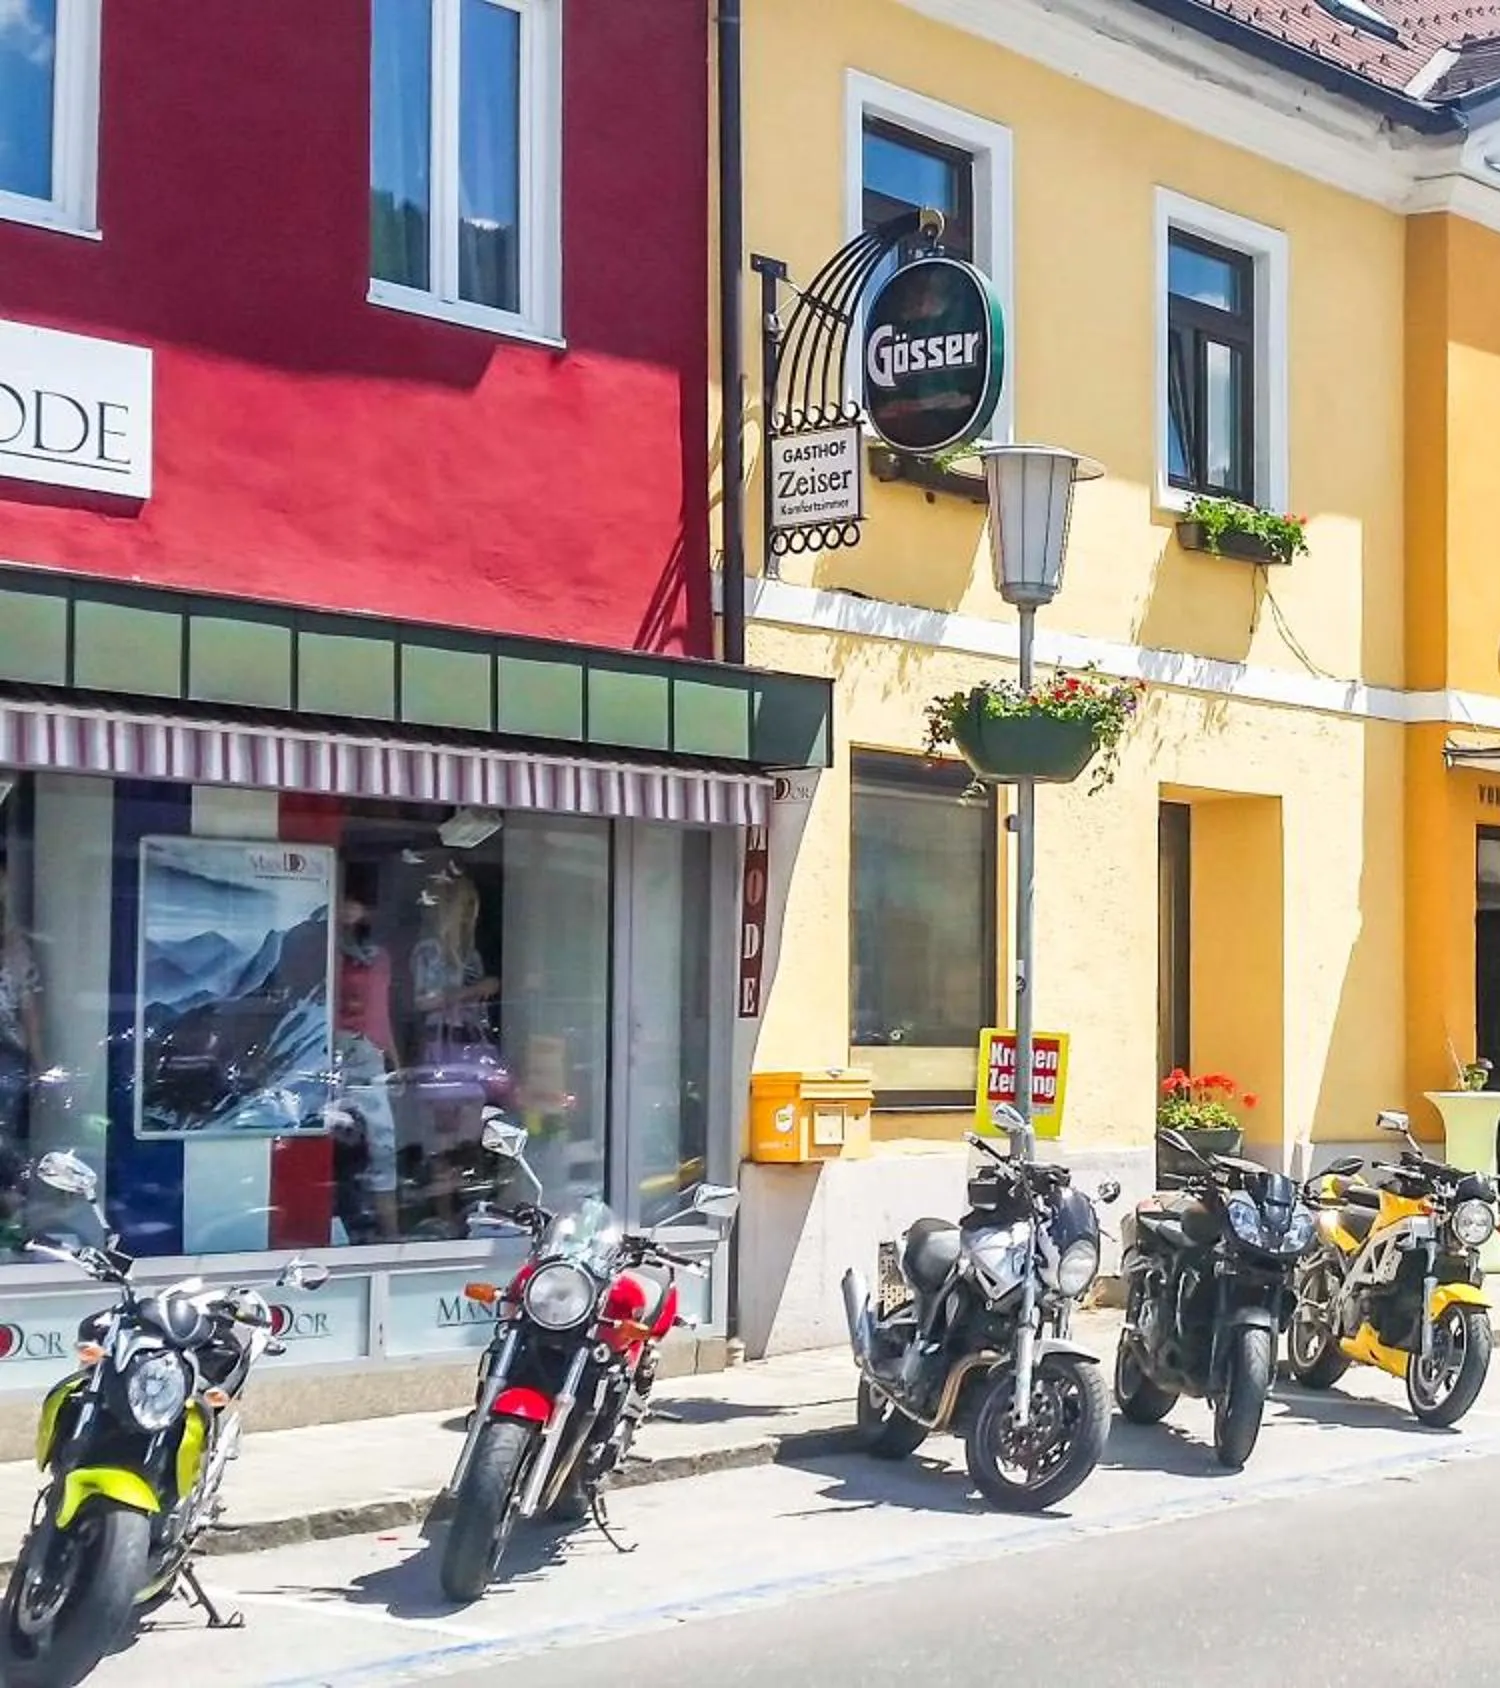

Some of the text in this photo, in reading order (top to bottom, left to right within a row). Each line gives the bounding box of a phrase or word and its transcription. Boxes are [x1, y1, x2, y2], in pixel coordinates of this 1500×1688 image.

[867, 325, 979, 387] Gösser
[783, 441, 847, 463] GASTHOF
[778, 466, 853, 498] Zeiser
[990, 1067, 1056, 1098] Zeing
